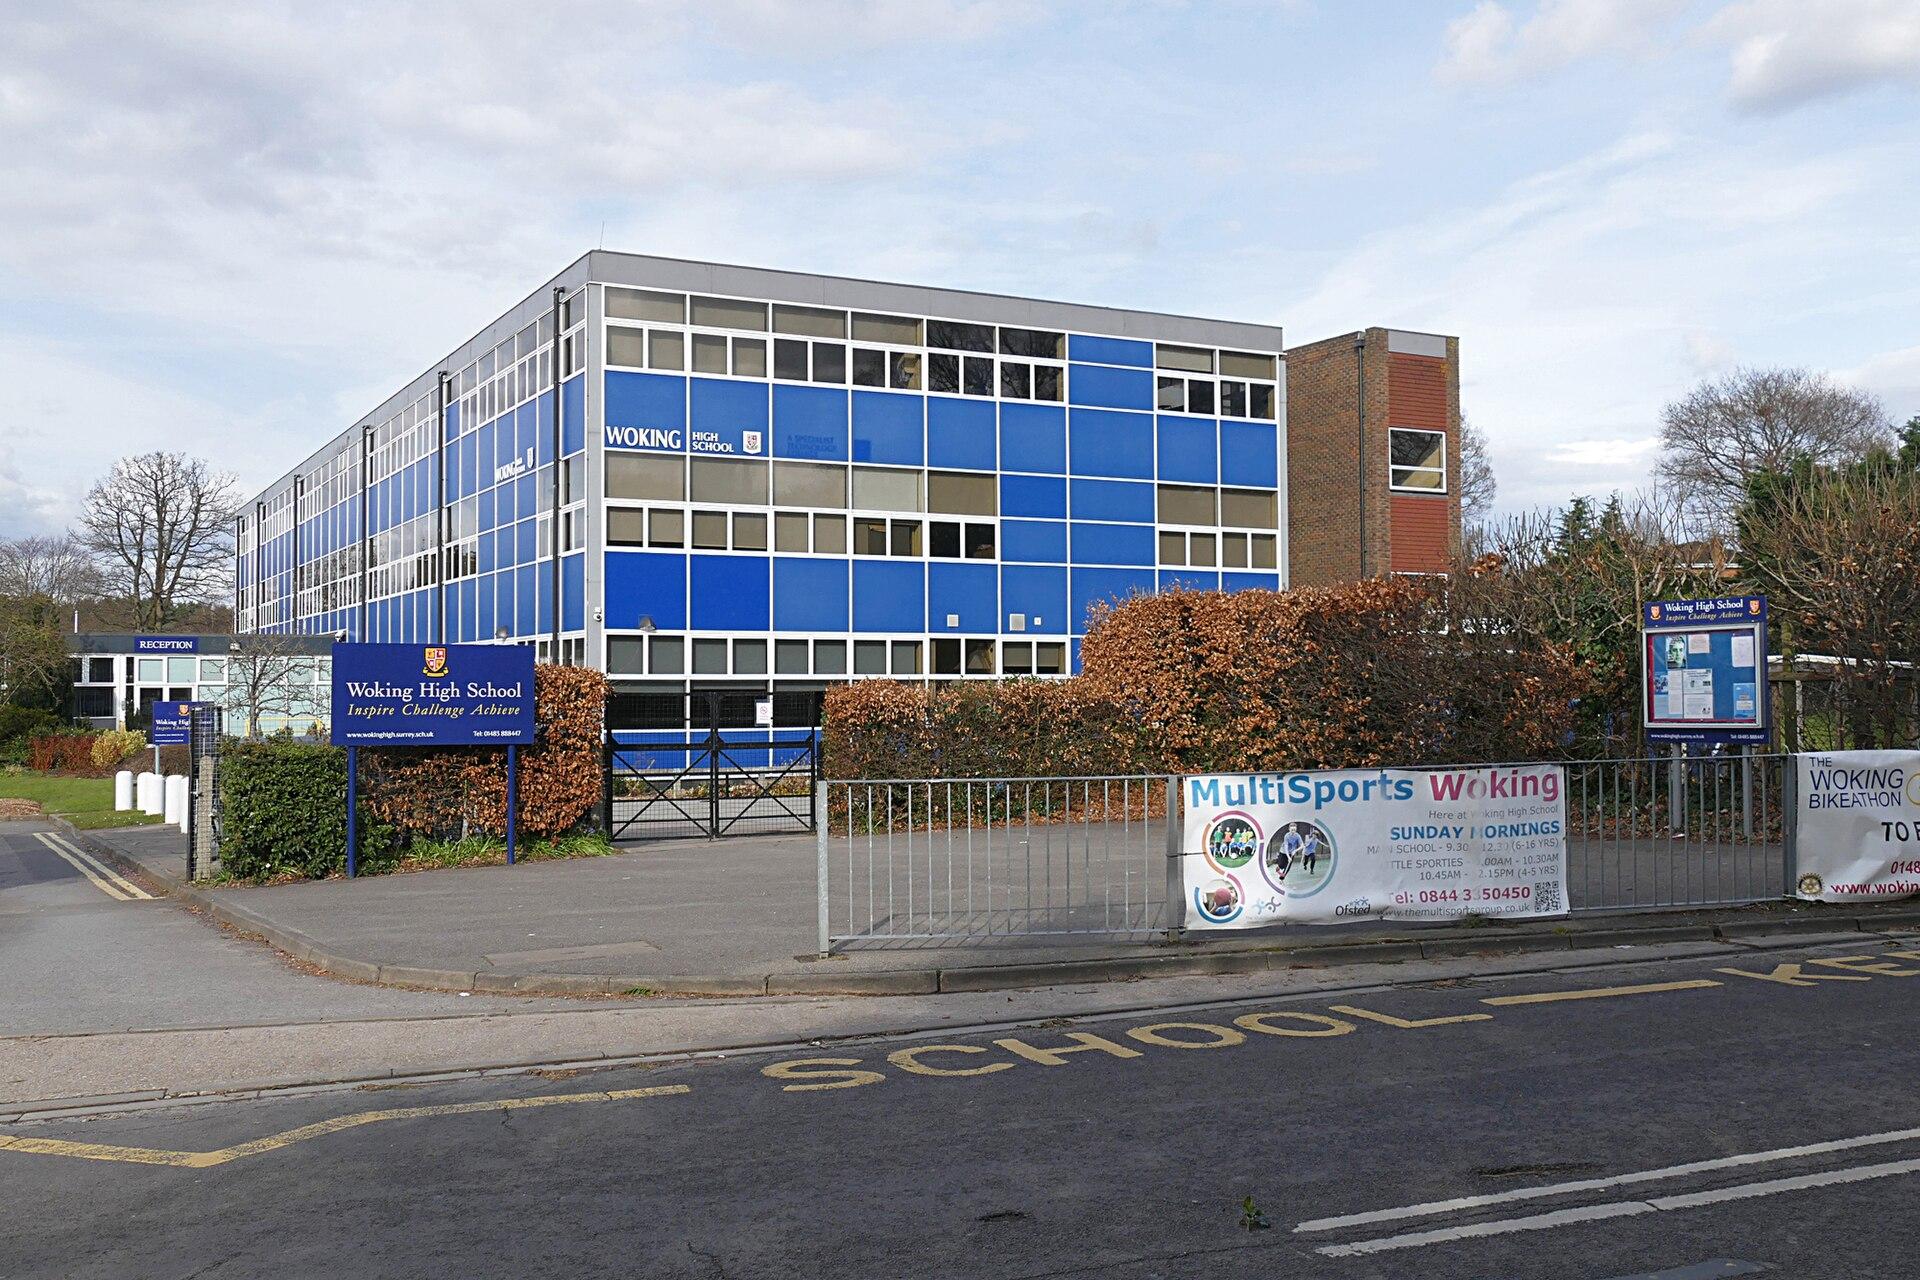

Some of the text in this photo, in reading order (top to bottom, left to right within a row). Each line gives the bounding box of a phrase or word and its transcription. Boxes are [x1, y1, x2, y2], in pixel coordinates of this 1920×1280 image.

[606, 426, 681, 449] WOKING
[692, 432, 719, 442] HIGH
[692, 440, 734, 453] SCHOOL
[1665, 599, 1744, 613] Woking High School
[140, 641, 193, 649] RECEPTION
[346, 682, 521, 702] Woking High School
[347, 703, 520, 719] Inspire Challenge Achieve
[1809, 757, 1832, 767] THE
[1810, 769, 1904, 791] WOKING
[1191, 770, 1559, 810] MultiSports Woking
[1809, 791, 1901, 809] BIKEATHON
[1429, 806, 1559, 820] Here at king High School
[1390, 826, 1464, 841] SUNDAY
[1881, 821, 1910, 842] TO
[1396, 843, 1436, 854] SCHOOL
[1446, 842, 1469, 852] 9.30
[1512, 840, 1536, 852] (6-16
[1538, 837, 1559, 848] YRS)
[1391, 860, 1413, 870] TTLE
[1416, 858, 1464, 869] SPORTIES
[1481, 857, 1512, 867] .00AM
[1523, 853, 1559, 865] 10.30AM
[1420, 870, 1461, 881] 10.45AM
[1518, 867, 1537, 878] (4-5
[1539, 865, 1559, 875] YRS)
[1831, 880, 1920, 894] www.wokin
[1390, 891, 1413, 904] el:
[1419, 890, 1458, 903] 0844
[1335, 904, 1371, 916] Ofsted
[760, 1004, 1494, 1092] SCHOOL
